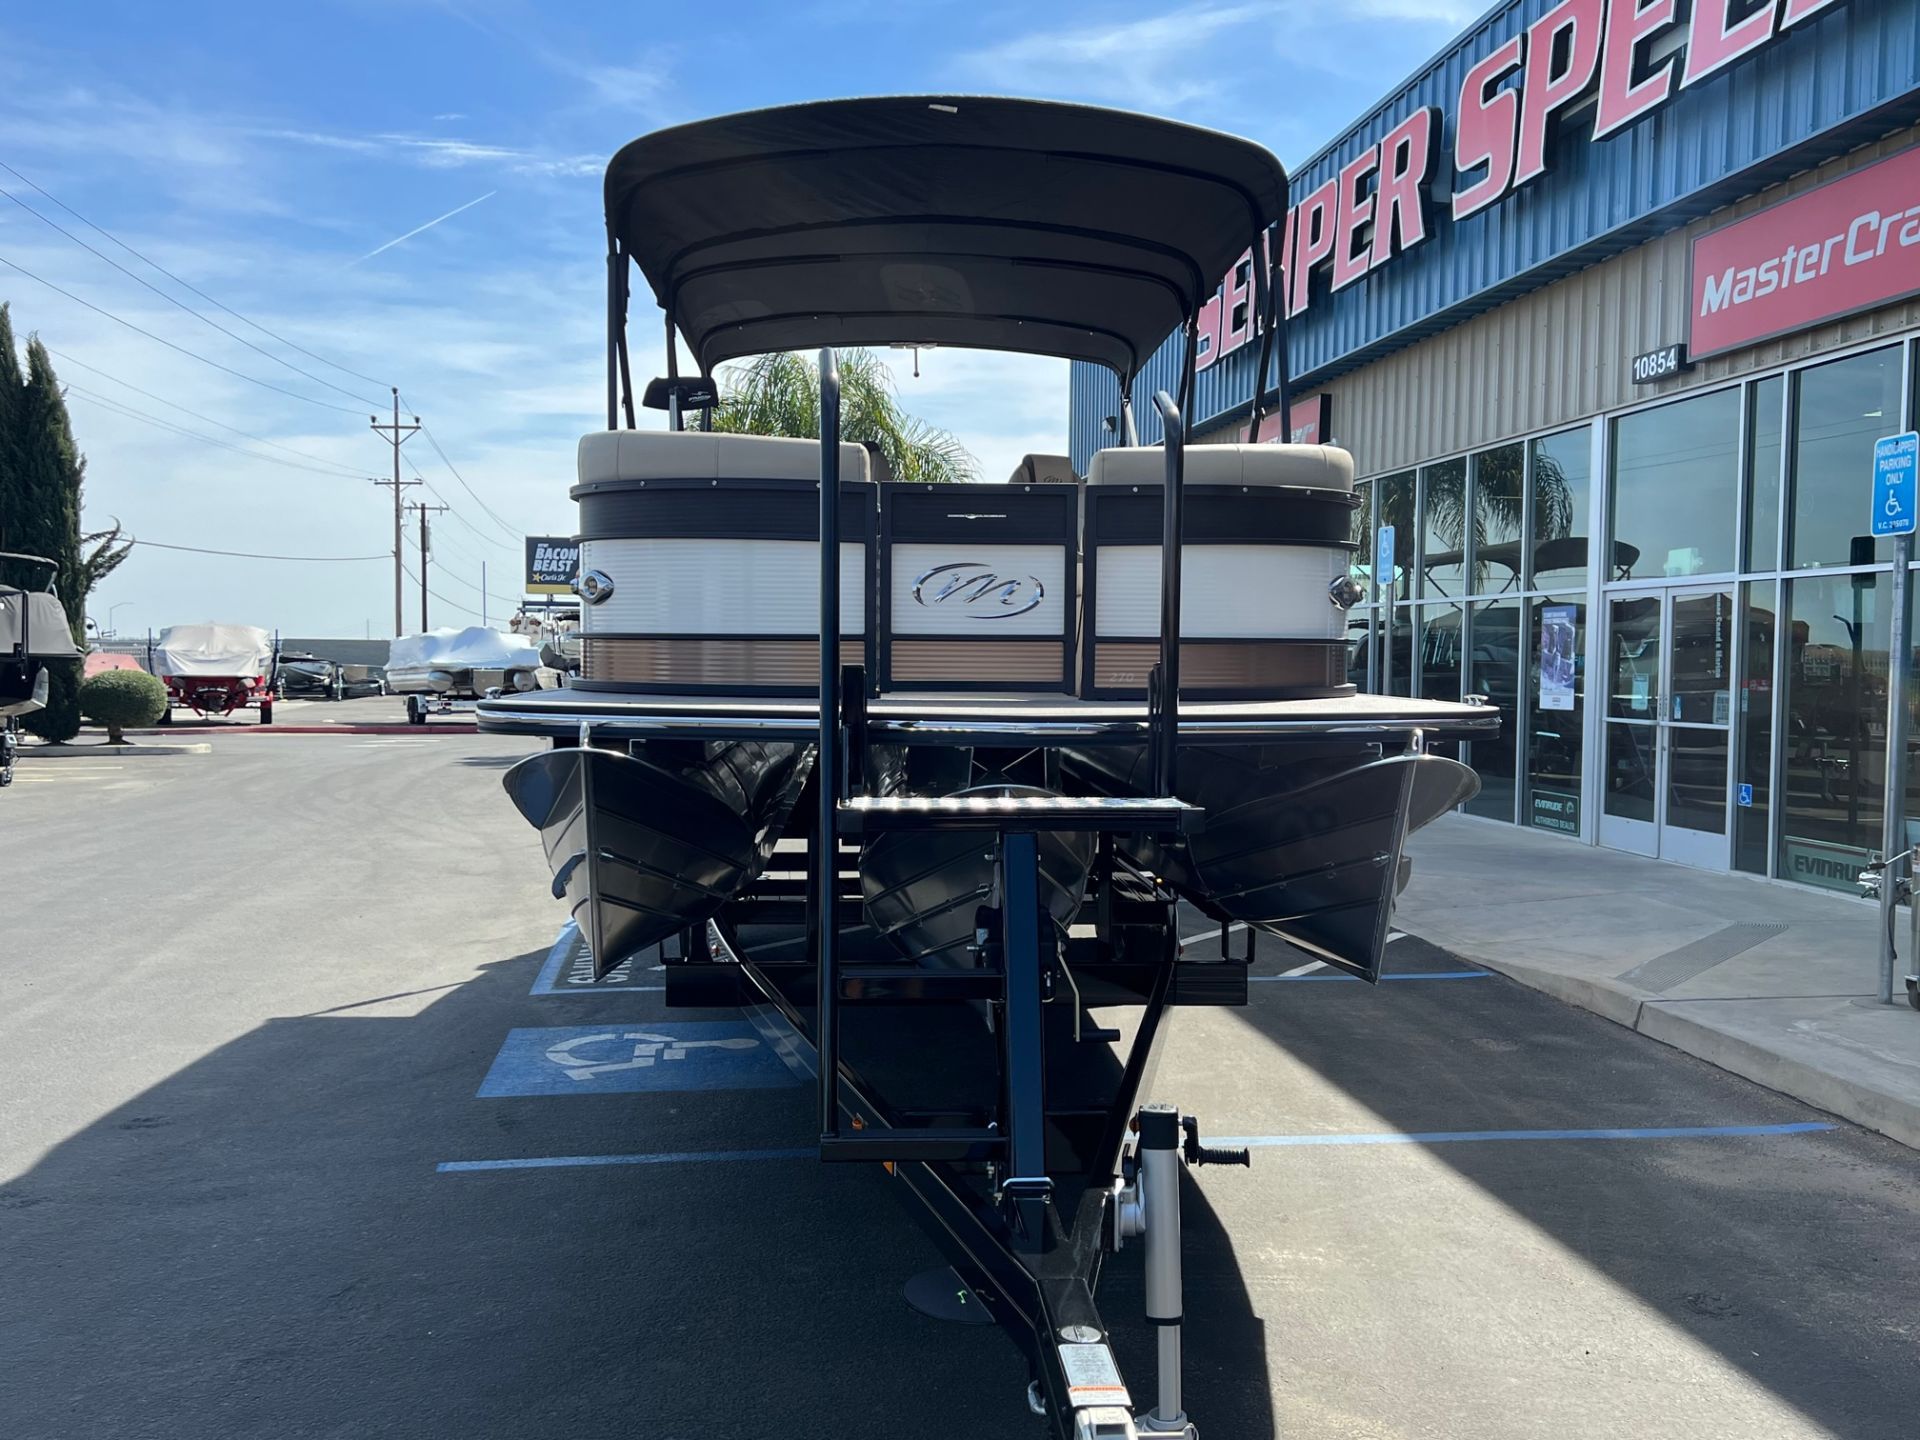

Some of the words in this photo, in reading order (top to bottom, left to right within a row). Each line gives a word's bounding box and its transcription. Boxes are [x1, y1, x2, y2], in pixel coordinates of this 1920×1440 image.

[1452, 0, 1837, 222] SPE
[1634, 348, 1676, 380] 10854
[1876, 439, 1916, 458] HANDICAPPED
[1879, 455, 1912, 472] PARKING
[1885, 472, 1904, 486] ONLY
[535, 547, 578, 560] BACON
[533, 559, 573, 572] BEAST
[1793, 854, 1864, 882] EVINRU
